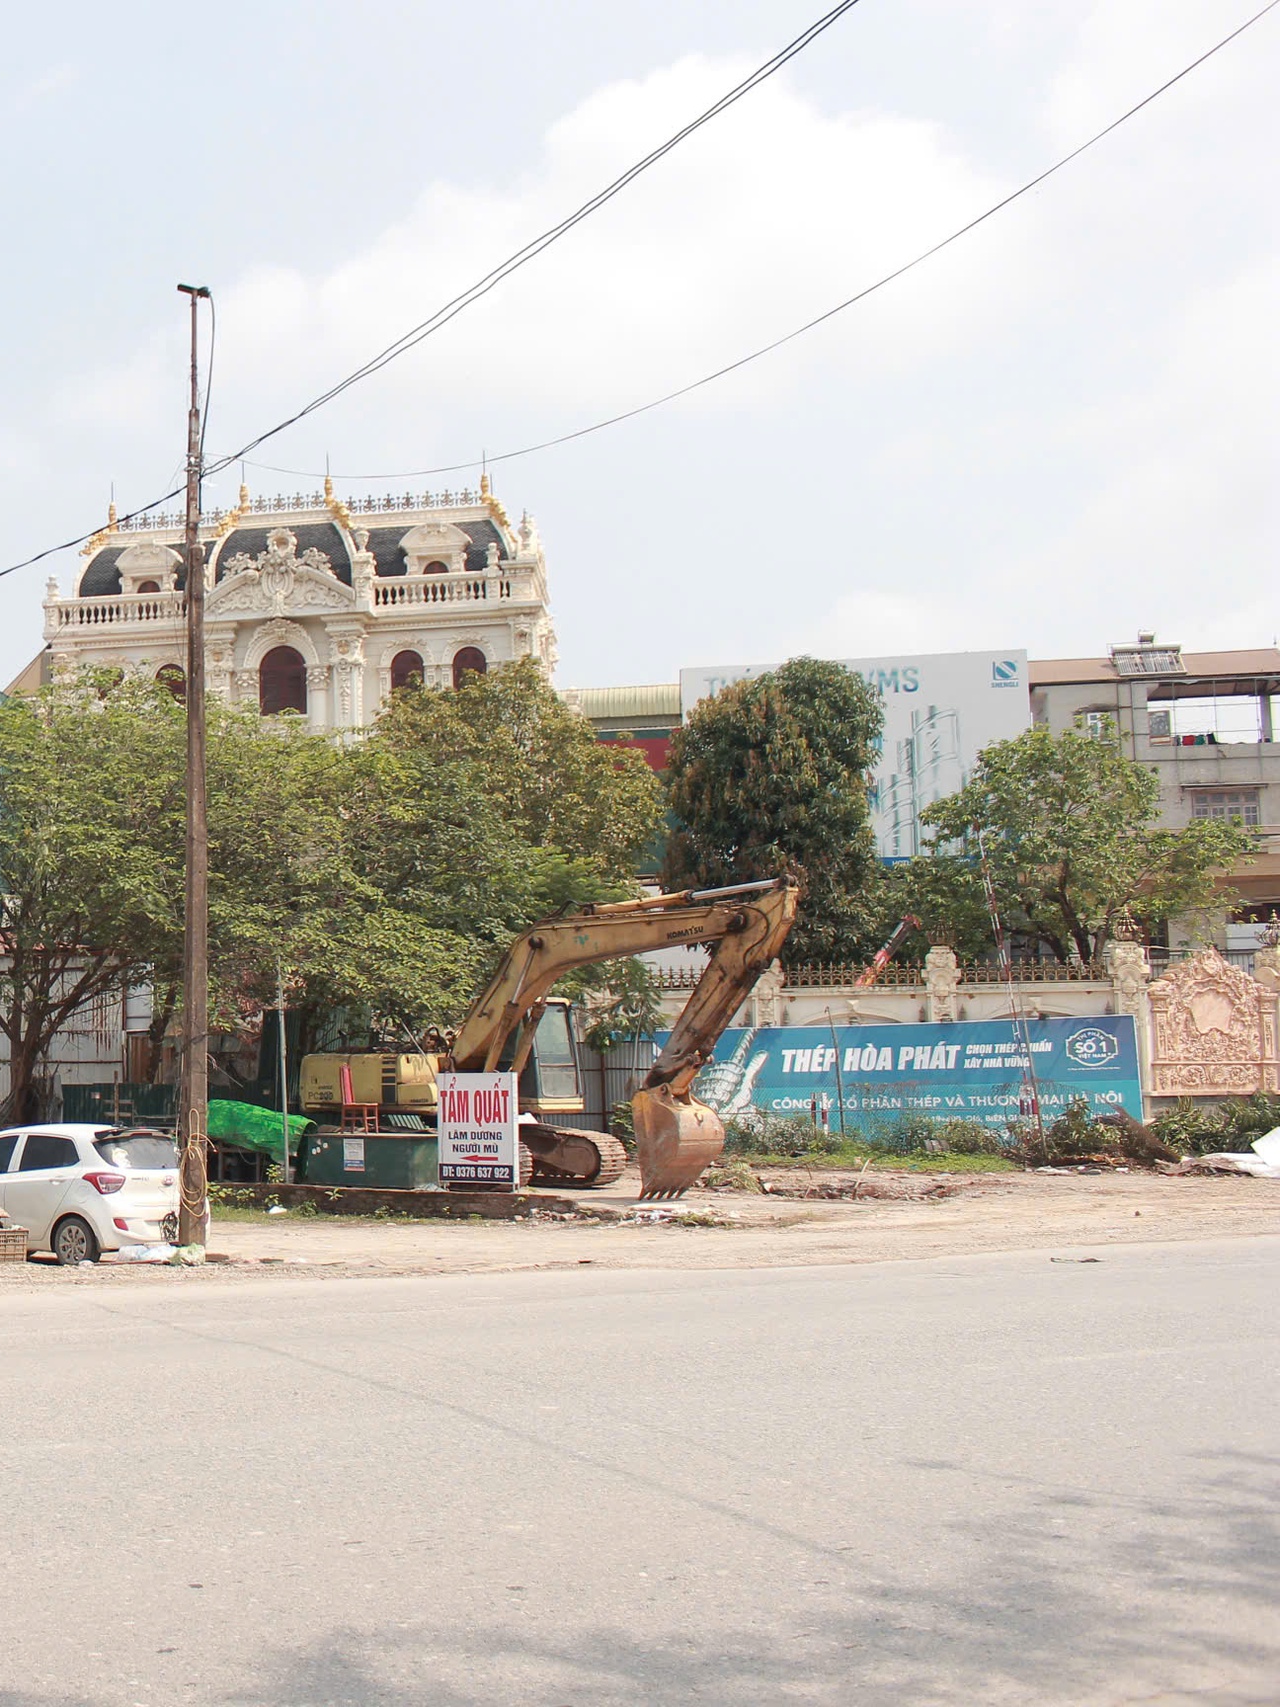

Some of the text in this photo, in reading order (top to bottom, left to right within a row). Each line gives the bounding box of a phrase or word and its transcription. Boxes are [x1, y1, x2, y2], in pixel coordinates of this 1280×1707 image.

[666, 925, 704, 940] KOMATSU
[966, 1043, 993, 1057] CHỌN
[1074, 1037, 1107, 1053] SỐ 1
[782, 1041, 961, 1072] THÉP HÒA PHÁT
[964, 1057, 982, 1068] XÂY
[983, 1056, 1003, 1068] NHÀ
[473, 1077, 509, 1127] QUẤT
[772, 1097, 812, 1109] CÔNG
[904, 1094, 941, 1107] THÉP
[946, 1093, 965, 1106] VÀ
[470, 1131, 503, 1141] DƯƠNG
[452, 1142, 499, 1153] NGƯỜI MÙ
[456, 1166, 476, 1178] 0376
[477, 1167, 493, 1178] 637
[494, 1167, 510, 1179] 922
